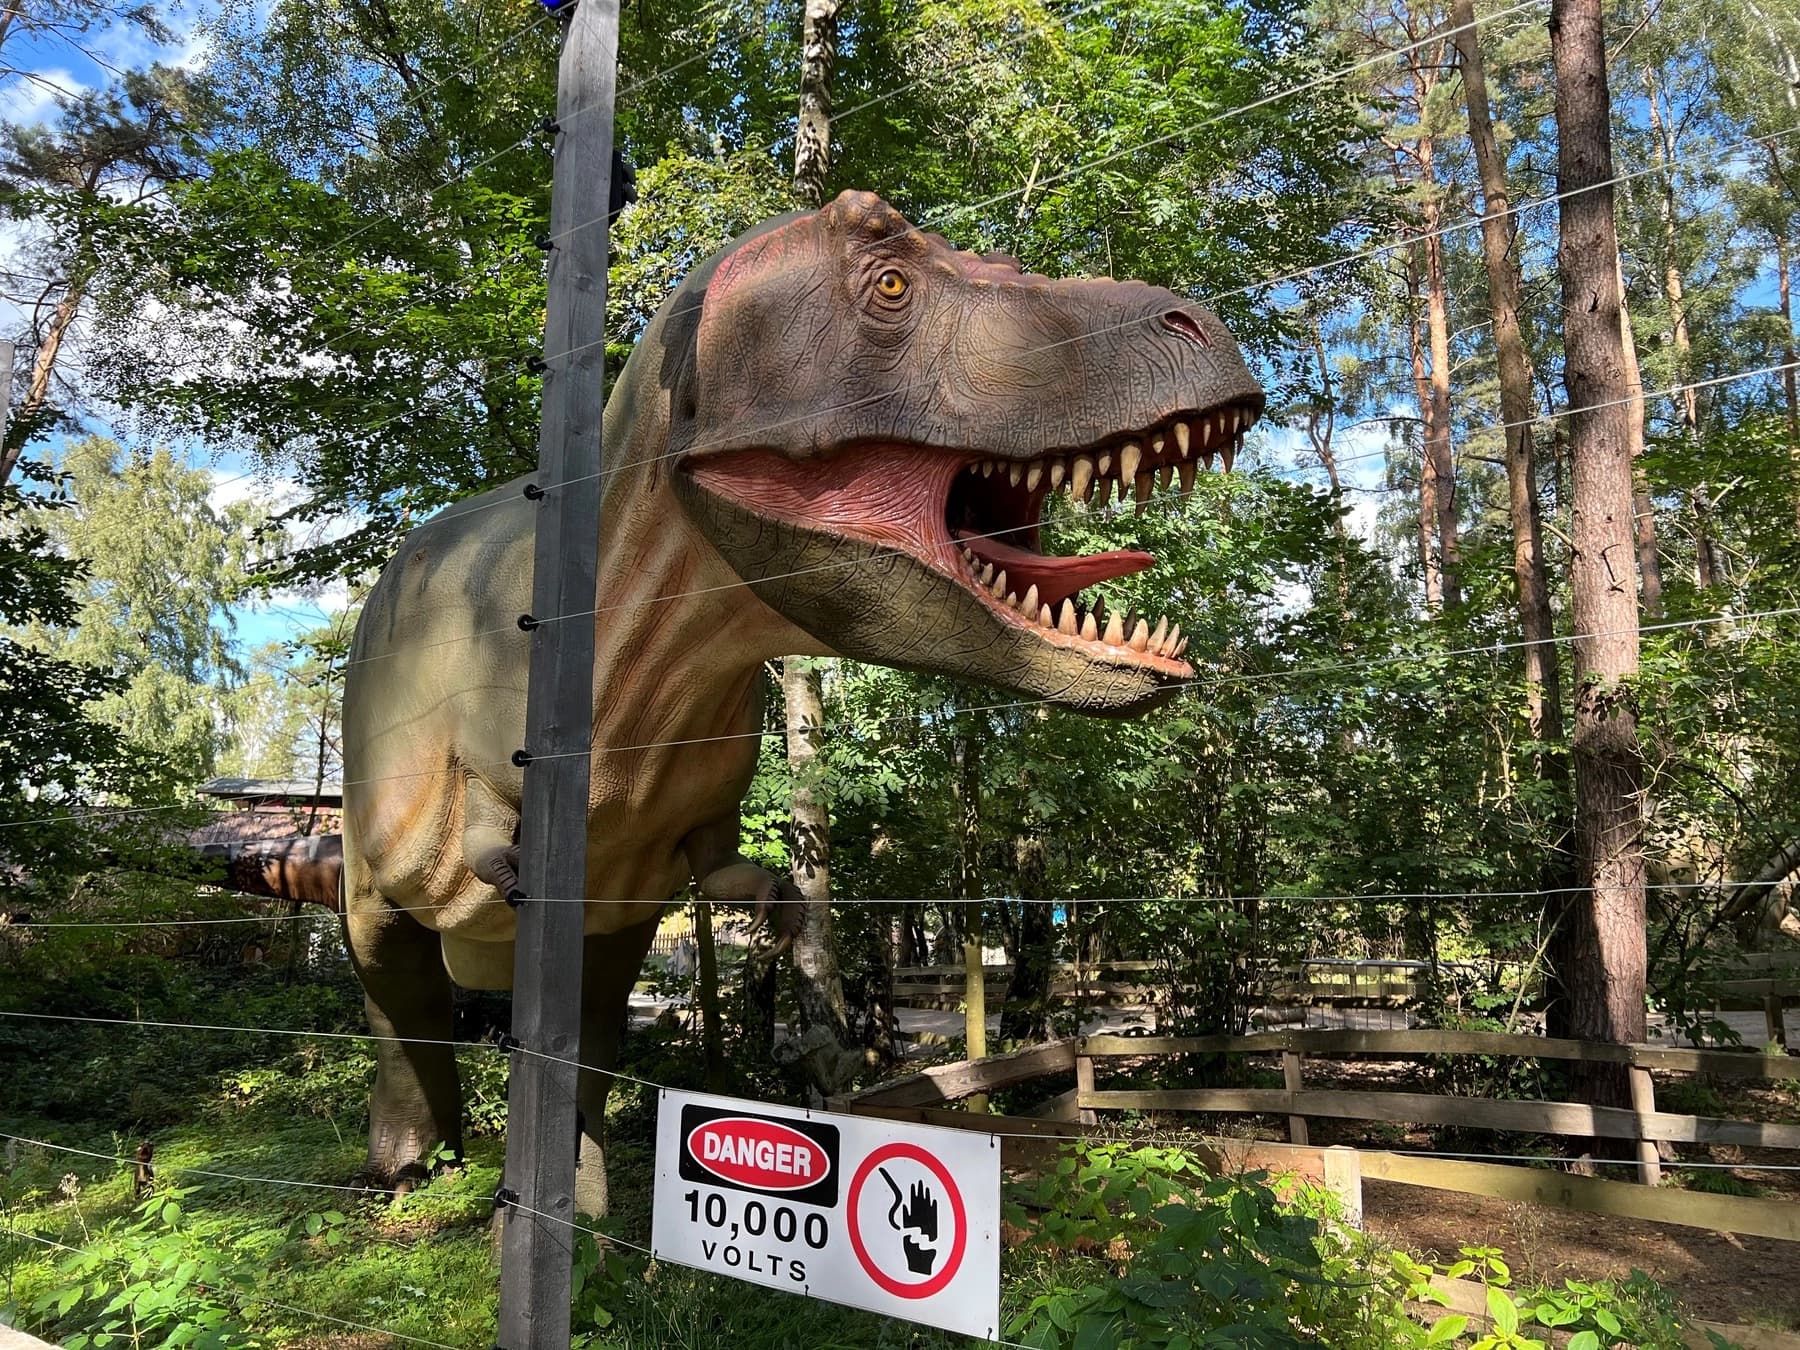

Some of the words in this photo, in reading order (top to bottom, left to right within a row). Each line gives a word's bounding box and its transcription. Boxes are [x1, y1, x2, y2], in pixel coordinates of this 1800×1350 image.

[703, 1131, 812, 1177] DANGER
[684, 1189, 829, 1249] 10,000
[701, 1239, 807, 1282] VOLTS
